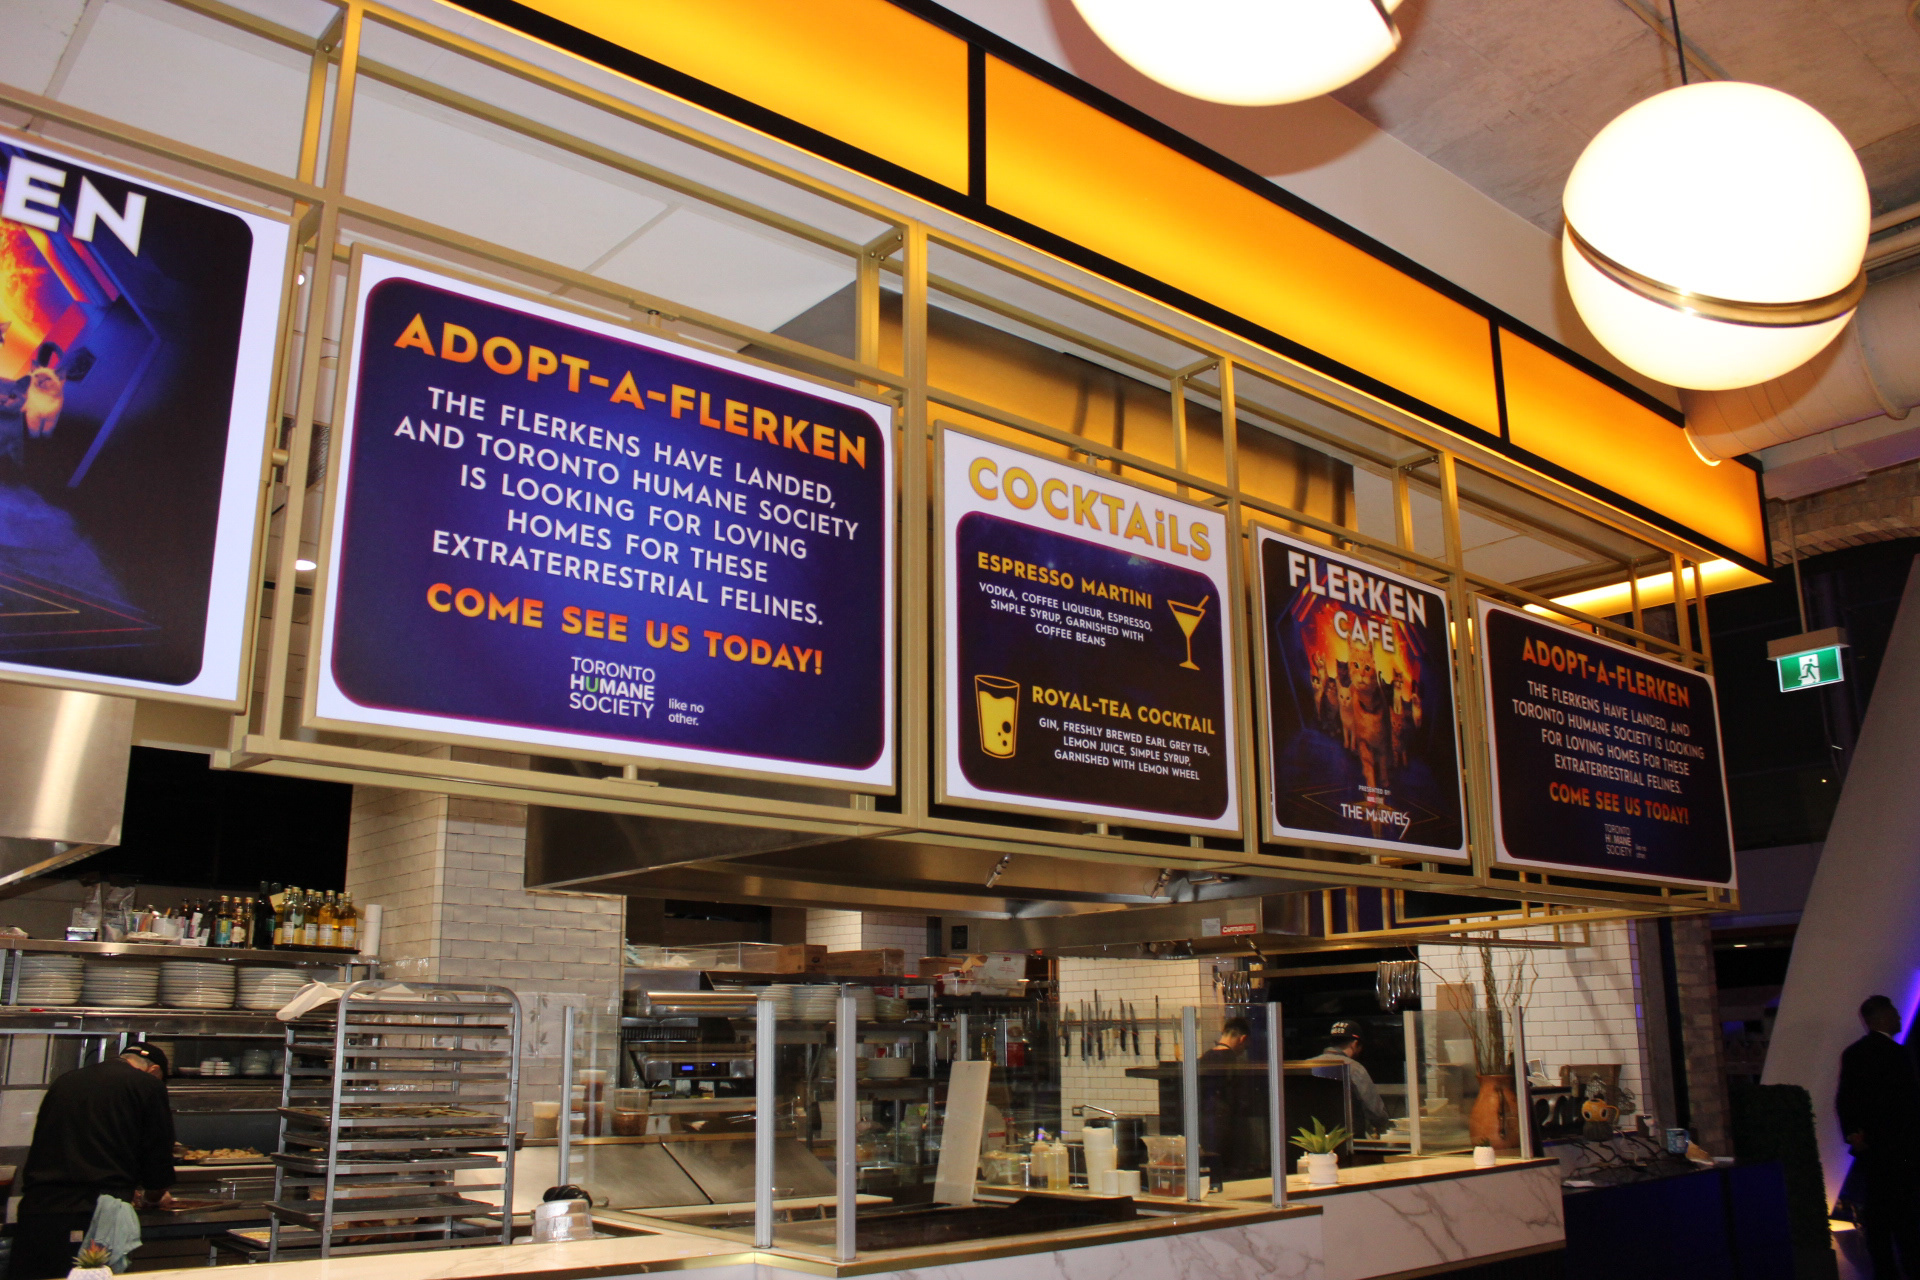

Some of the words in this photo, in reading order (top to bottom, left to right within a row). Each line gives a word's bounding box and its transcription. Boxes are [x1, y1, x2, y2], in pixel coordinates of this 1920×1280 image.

[394, 313, 866, 469] ADOPT-A-FLERKEN
[428, 387, 485, 422] THE
[501, 405, 640, 457] FLERKENS
[654, 443, 722, 477] HAVE
[735, 463, 837, 509] LANDED,
[394, 415, 465, 450] AND
[477, 433, 619, 485] TORONTO
[632, 470, 746, 515] HUMANE
[759, 500, 858, 540] SOCIETY
[461, 464, 485, 489] IS
[501, 473, 634, 521] LOOKING
[649, 506, 701, 536] FOR
[715, 520, 807, 559] LOVING
[507, 510, 610, 550] HOMES
[626, 534, 679, 564] FOR
[691, 547, 767, 582] THESE
[433, 531, 708, 603] EXTRATERRESTRIAL
[720, 586, 823, 625] FELINES.
[978, 552, 1074, 589] ESPRESSO
[1082, 577, 1152, 610] MARTINI
[1288, 551, 1427, 628] FLERKEN
[427, 583, 542, 628] COME
[562, 606, 627, 642] SEE
[646, 620, 689, 652] US
[704, 630, 823, 674] TODAY!
[979, 582, 1017, 601] VODKA,
[1022, 592, 1058, 610] COFFEE
[1062, 600, 1104, 620] LIQUEUR,
[1108, 612, 1152, 631] ESPRESSO,
[991, 599, 1025, 615] SIMPLE
[1030, 607, 1062, 625] SYRUP,
[1066, 614, 1118, 636] GARNISHED
[1122, 628, 1144, 642] WITH
[1036, 624, 1072, 641] COFFEE
[1076, 631, 1106, 647] BEANS
[1333, 611, 1394, 654] CAFÉ
[570, 674, 654, 701] HUMANE
[571, 656, 656, 683] TORONTO
[1522, 636, 1690, 708] ADOPT-A-FLERKEN
[569, 692, 654, 719] SOCIETY
[668, 698, 687, 710] like
[690, 704, 704, 713] no
[668, 714, 699, 726] other.
[1032, 686, 1131, 719] ROYAL-TEA
[1138, 706, 1215, 734] COCKTAIL
[1528, 681, 1547, 700] THE
[1552, 686, 1600, 714] FLERKENS
[1604, 700, 1628, 720] HAVE
[1671, 719, 1690, 736] AND
[1039, 718, 1060, 731] GIN,
[1063, 722, 1102, 737] FRESHLY
[1106, 729, 1142, 744] BREWED
[1146, 736, 1166, 748] EARL
[1169, 740, 1190, 752] GREY
[1194, 743, 1210, 756] TEA,
[1063, 737, 1097, 751] LEMON
[1100, 742, 1126, 756] JUICE,
[1130, 747, 1160, 761] SIMPLE
[1164, 753, 1191, 766] SYRUP,
[1512, 699, 1565, 727] TORONTO
[1569, 712, 1611, 738] HUMANE
[1614, 724, 1651, 747] SOCIETY
[1654, 733, 1662, 749] IS
[1665, 736, 1704, 760] LOOKING
[1542, 728, 1562, 747] FOR
[1566, 734, 1603, 756] LOVING
[1607, 744, 1640, 766] HOMES
[1643, 752, 1661, 768] FOR
[1663, 756, 1690, 775] THESE
[1055, 750, 1109, 767] GARNISHED
[1113, 759, 1135, 771] WITH
[1139, 763, 1169, 776] LEMON
[1172, 768, 1200, 780] WHEEL
[1555, 753, 1644, 787] EXTRATERRESTRIAL
[1341, 804, 1362, 819] THE
[1366, 808, 1410, 839] MARVELS
[1550, 782, 1589, 807] COME
[1595, 792, 1620, 814] SEE
[1624, 798, 1640, 817] US
[1645, 801, 1689, 825] TODAY!
